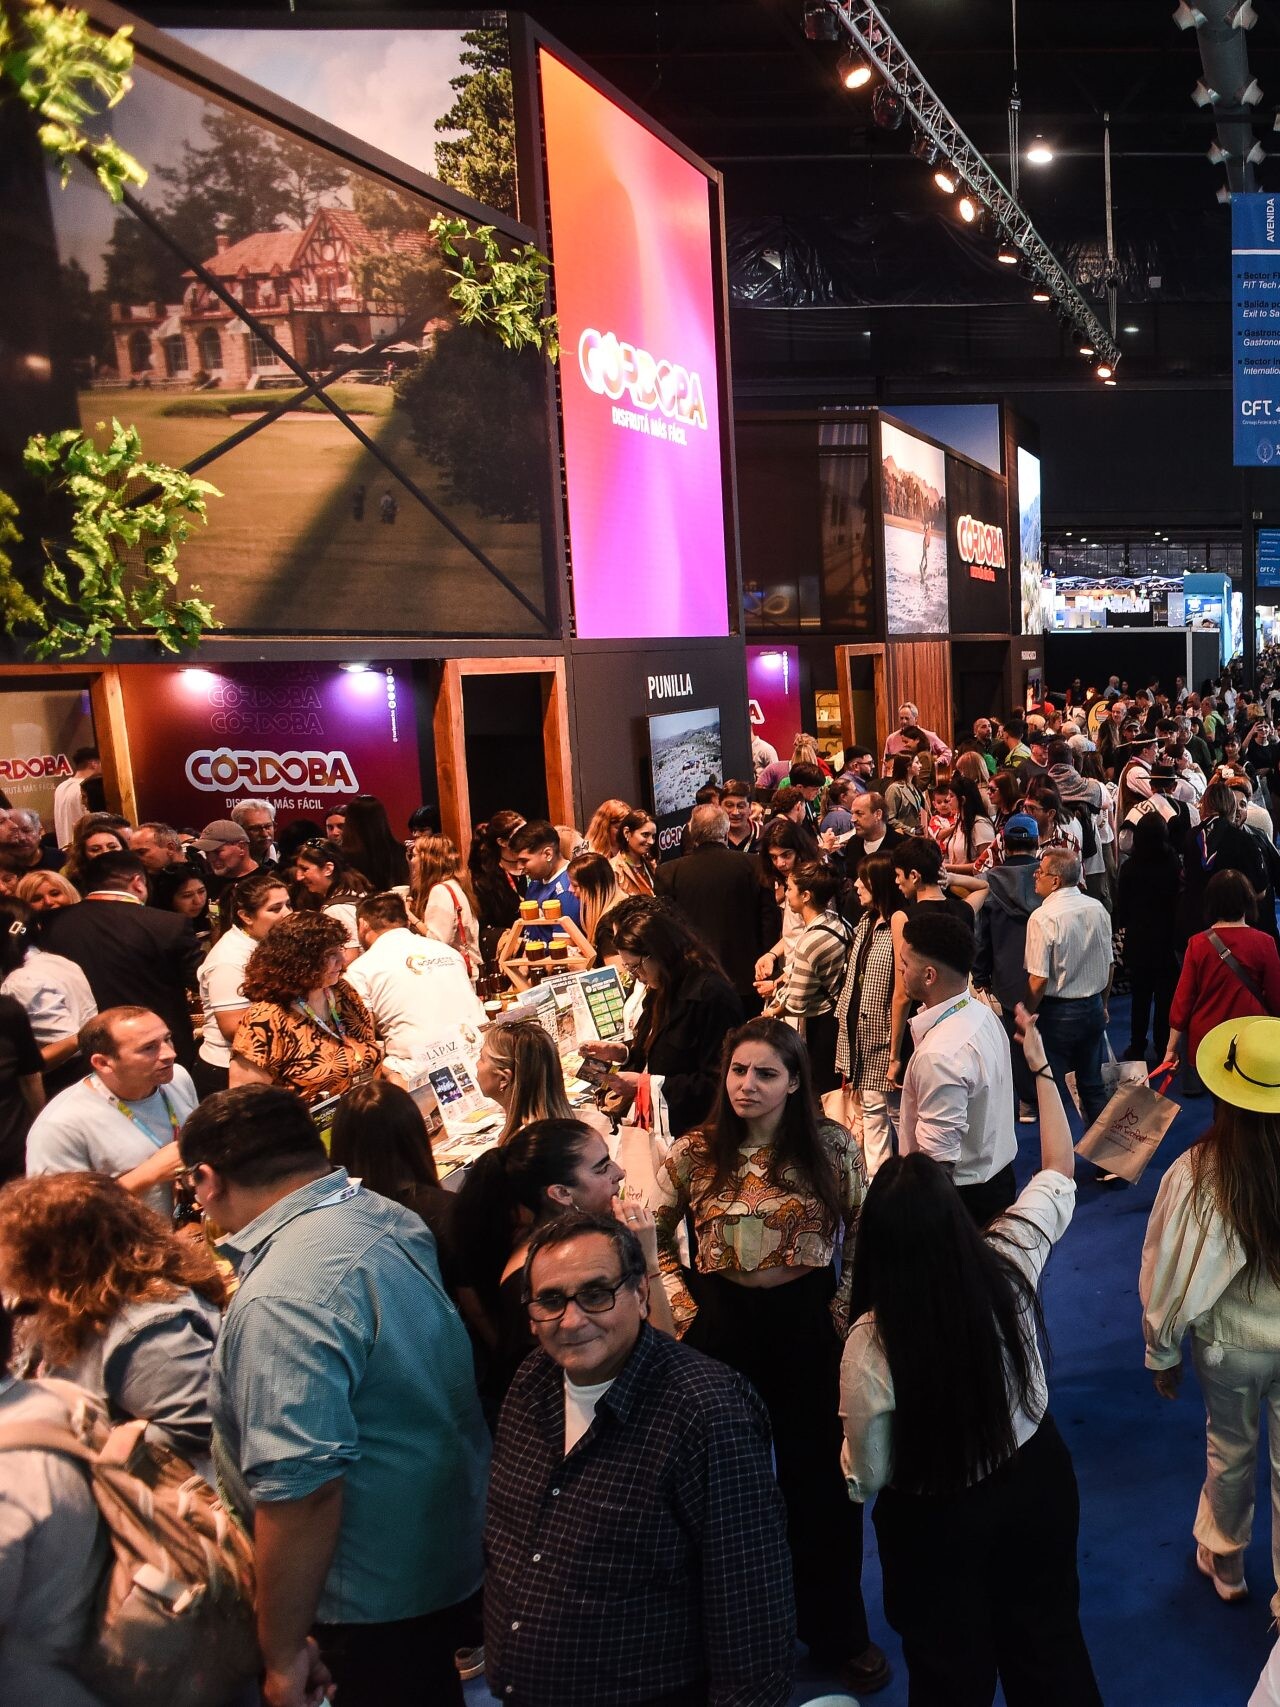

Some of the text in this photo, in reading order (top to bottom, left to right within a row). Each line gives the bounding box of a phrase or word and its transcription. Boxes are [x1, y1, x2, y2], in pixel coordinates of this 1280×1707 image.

[1266, 197, 1275, 243] AVENIDA
[1242, 281, 1256, 289] FIT
[1258, 280, 1277, 289] Tech
[1242, 309, 1258, 318] Exit
[1259, 310, 1267, 318] to
[1243, 300, 1269, 308] Salida
[1244, 357, 1272, 365] Sector
[1241, 400, 1272, 416] CFT
[611, 406, 688, 446] DISFRUTÁ MÁS FÁCIL
[957, 514, 1006, 569] CÓRDOBA
[648, 673, 693, 700] PUNILLA
[187, 749, 357, 791] CÓRDOBA
[273, 796, 295, 809] MÁS
[297, 797, 324, 810] FÁCIL
[659, 824, 687, 850] CÓRD
